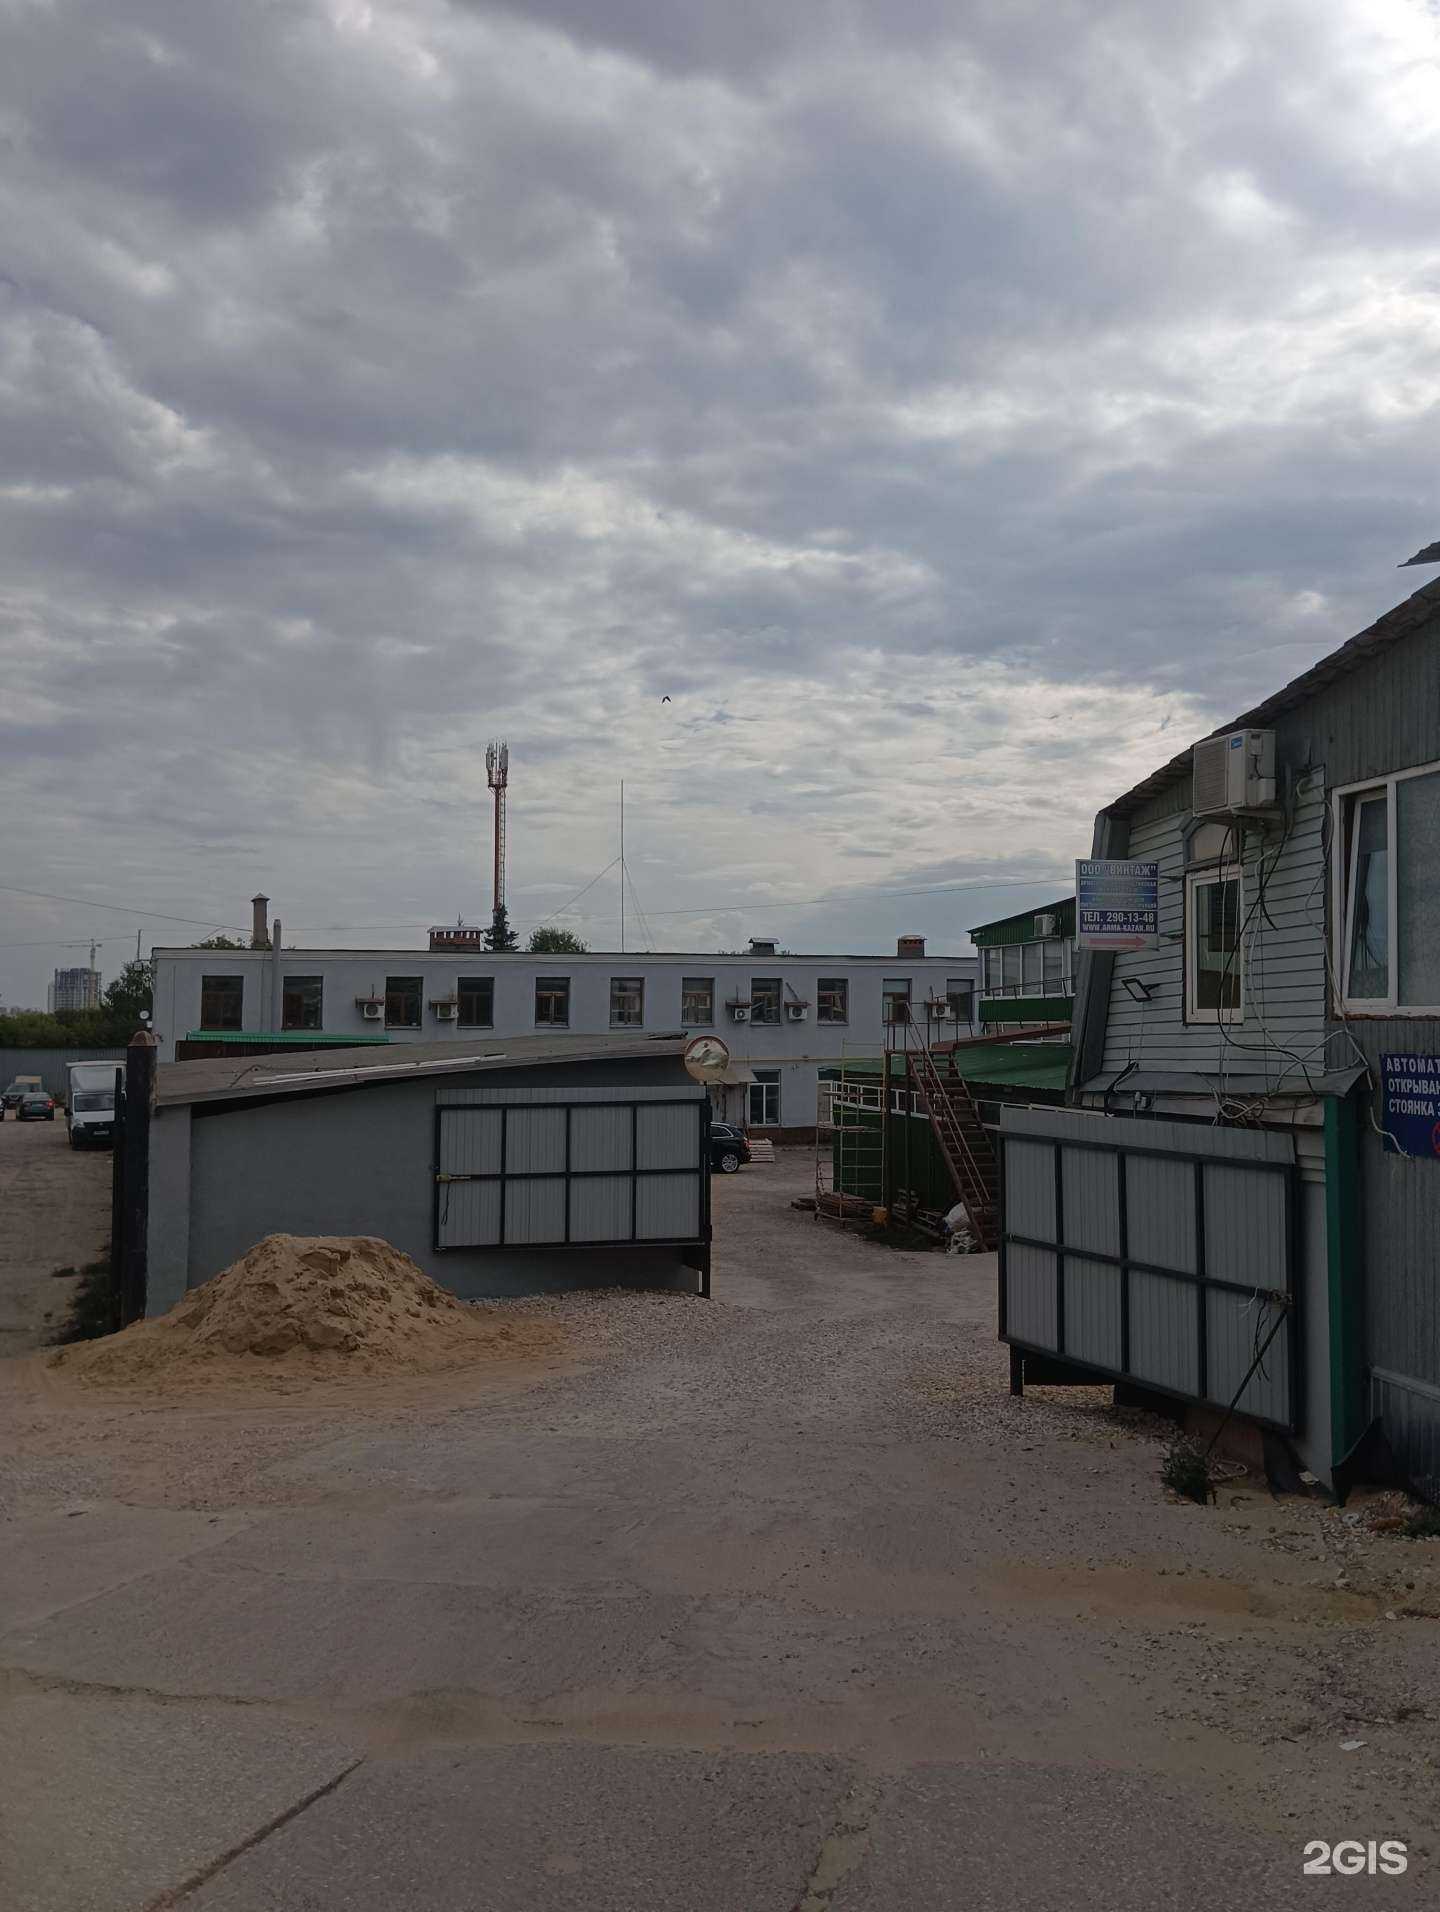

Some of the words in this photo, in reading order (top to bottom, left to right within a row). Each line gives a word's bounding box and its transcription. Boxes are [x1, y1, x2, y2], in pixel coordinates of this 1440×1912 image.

[1081, 863, 1100, 875] ООО
[1082, 911, 1103, 922] ТЕЛ.
[1389, 1098, 1435, 1117] СТОЯНКА
